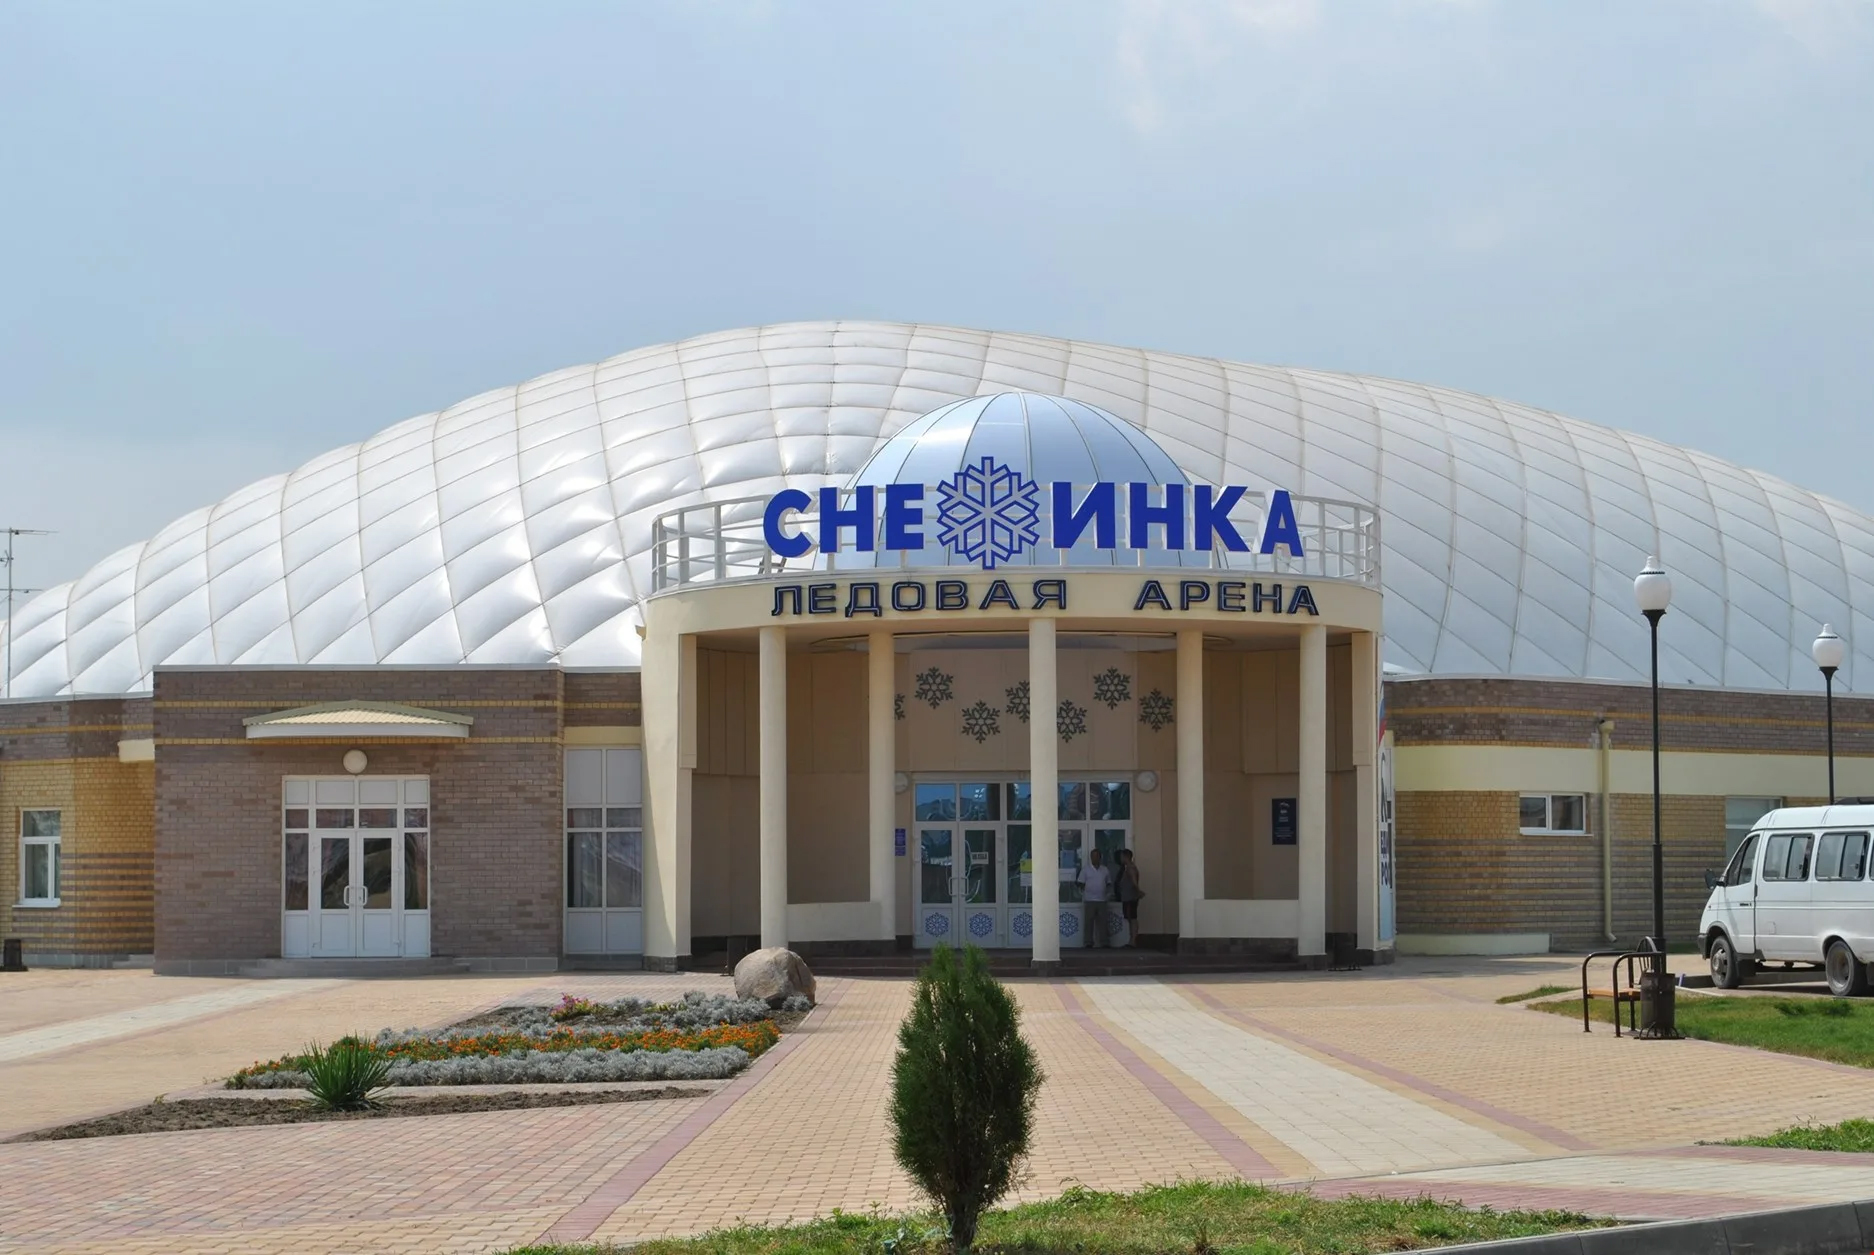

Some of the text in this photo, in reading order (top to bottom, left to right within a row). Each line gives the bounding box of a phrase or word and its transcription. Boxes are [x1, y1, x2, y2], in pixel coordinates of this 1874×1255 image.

[763, 456, 1304, 570] СНЕИНКА
[771, 579, 1320, 618] ЛЕДОВАЯ АРЕНА
